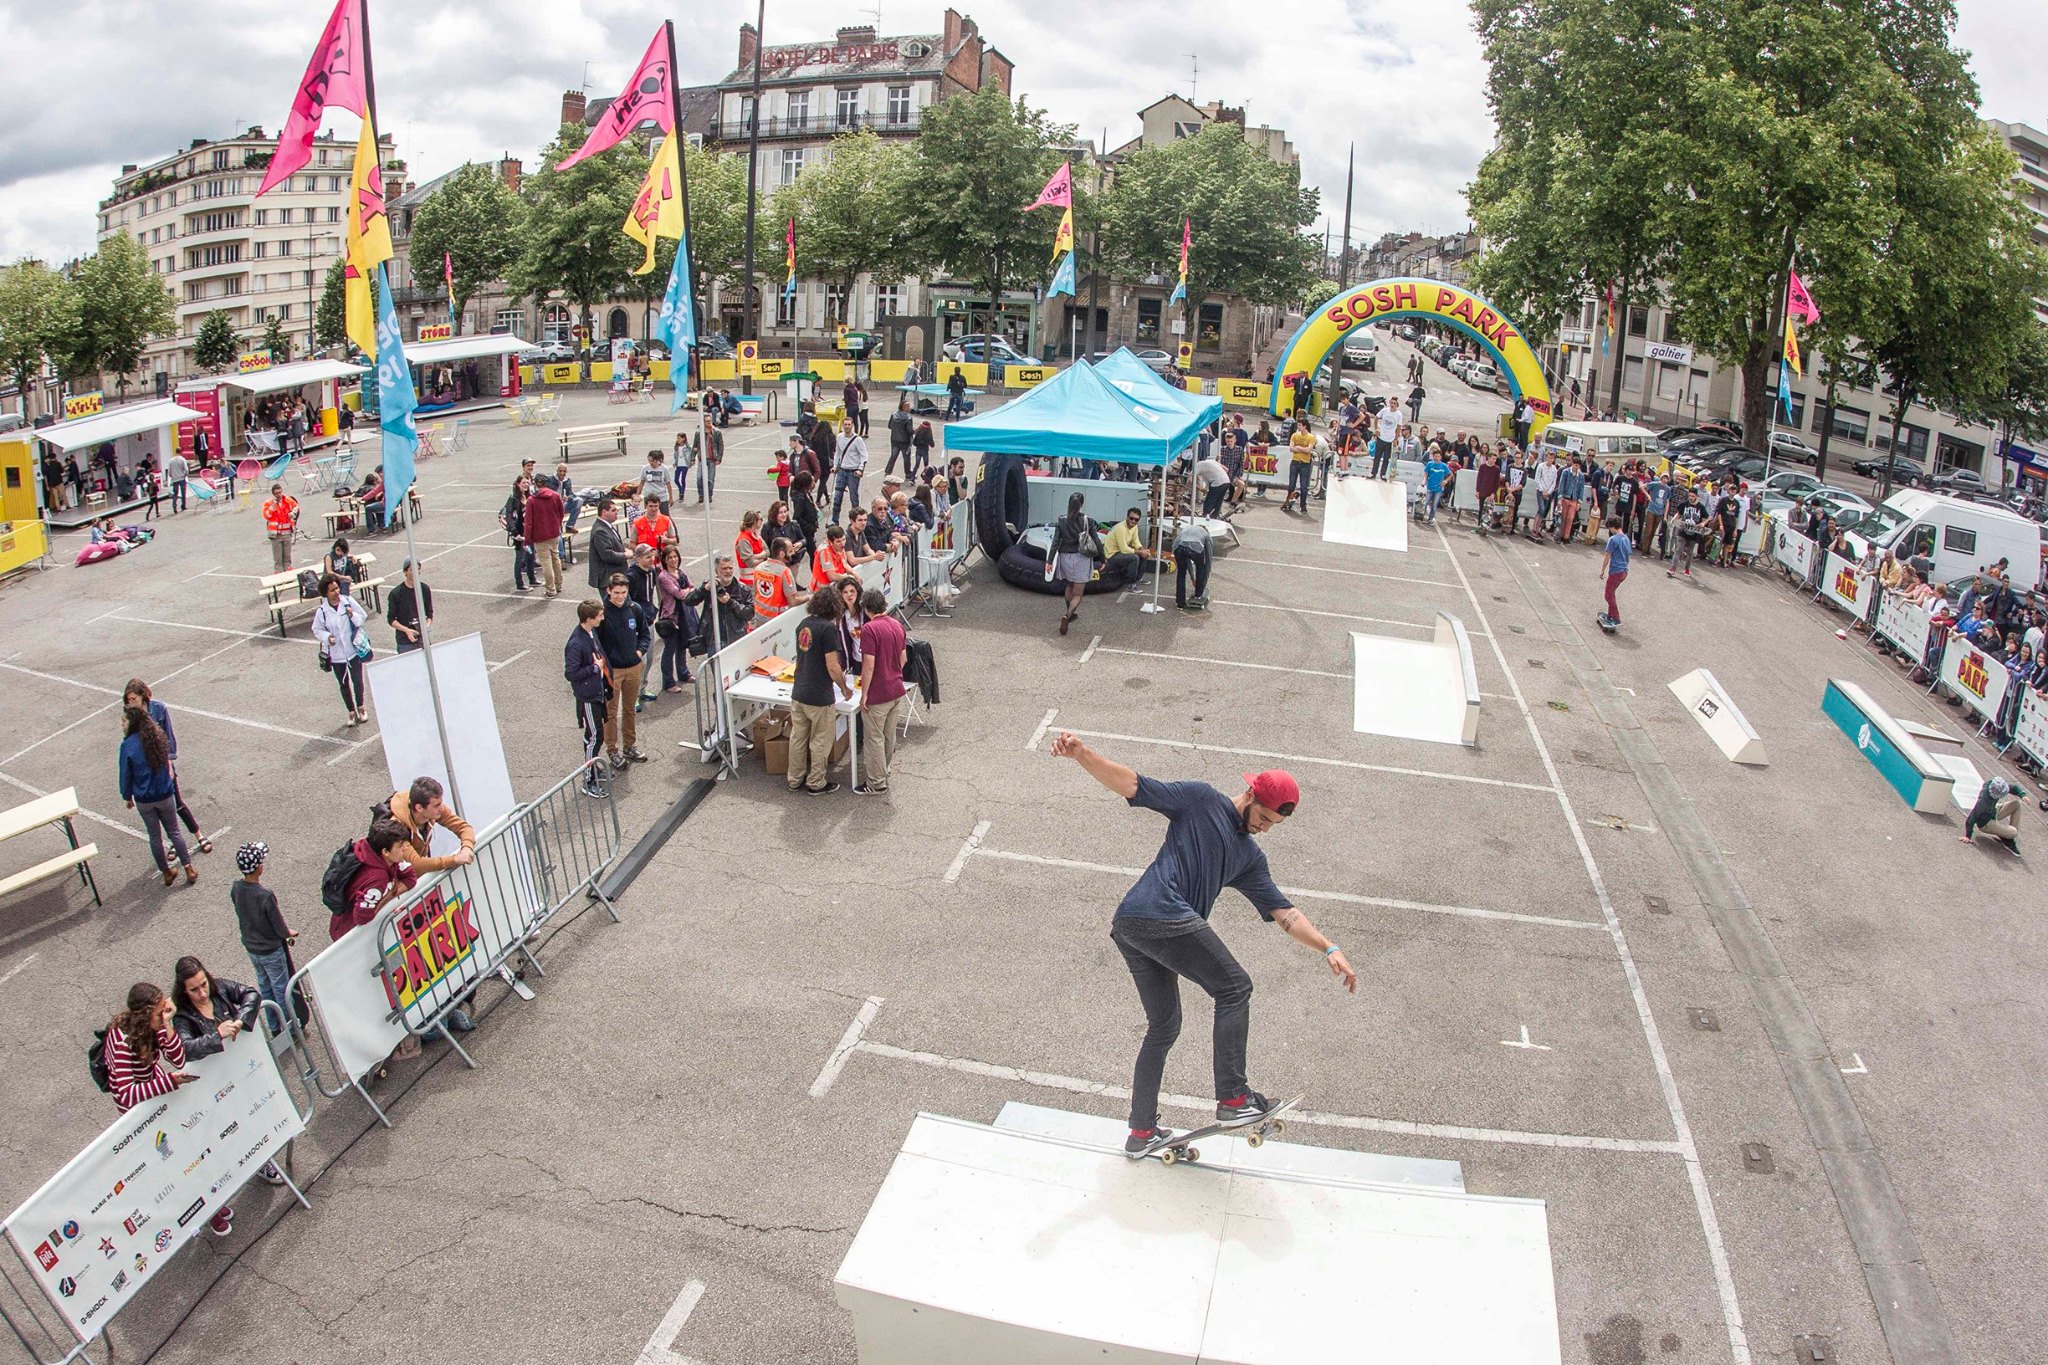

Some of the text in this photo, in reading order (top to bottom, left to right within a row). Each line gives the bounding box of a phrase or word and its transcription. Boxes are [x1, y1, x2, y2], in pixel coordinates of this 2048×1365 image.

[762, 43, 898, 68] HOTEL DE PARIS
[1327, 284, 1519, 351] SOSH PARK
[420, 326, 451, 340] STORE
[1650, 346, 1686, 361] galtier
[554, 367, 569, 377] Sosh
[762, 364, 781, 372] Sosh
[1021, 371, 1042, 380] Sosh
[1234, 387, 1256, 397] Sosh
[1244, 459, 1278, 473] ARK
[1836, 574, 1858, 602] PARK
[1958, 659, 1990, 698] PARK
[380, 897, 480, 1010] PARK
[112, 1103, 168, 1155] Sosh remercie
[219, 1120, 239, 1140] soma
[238, 1134, 270, 1167] X-MOOVE
[80, 1295, 109, 1325] G-SHOCK
